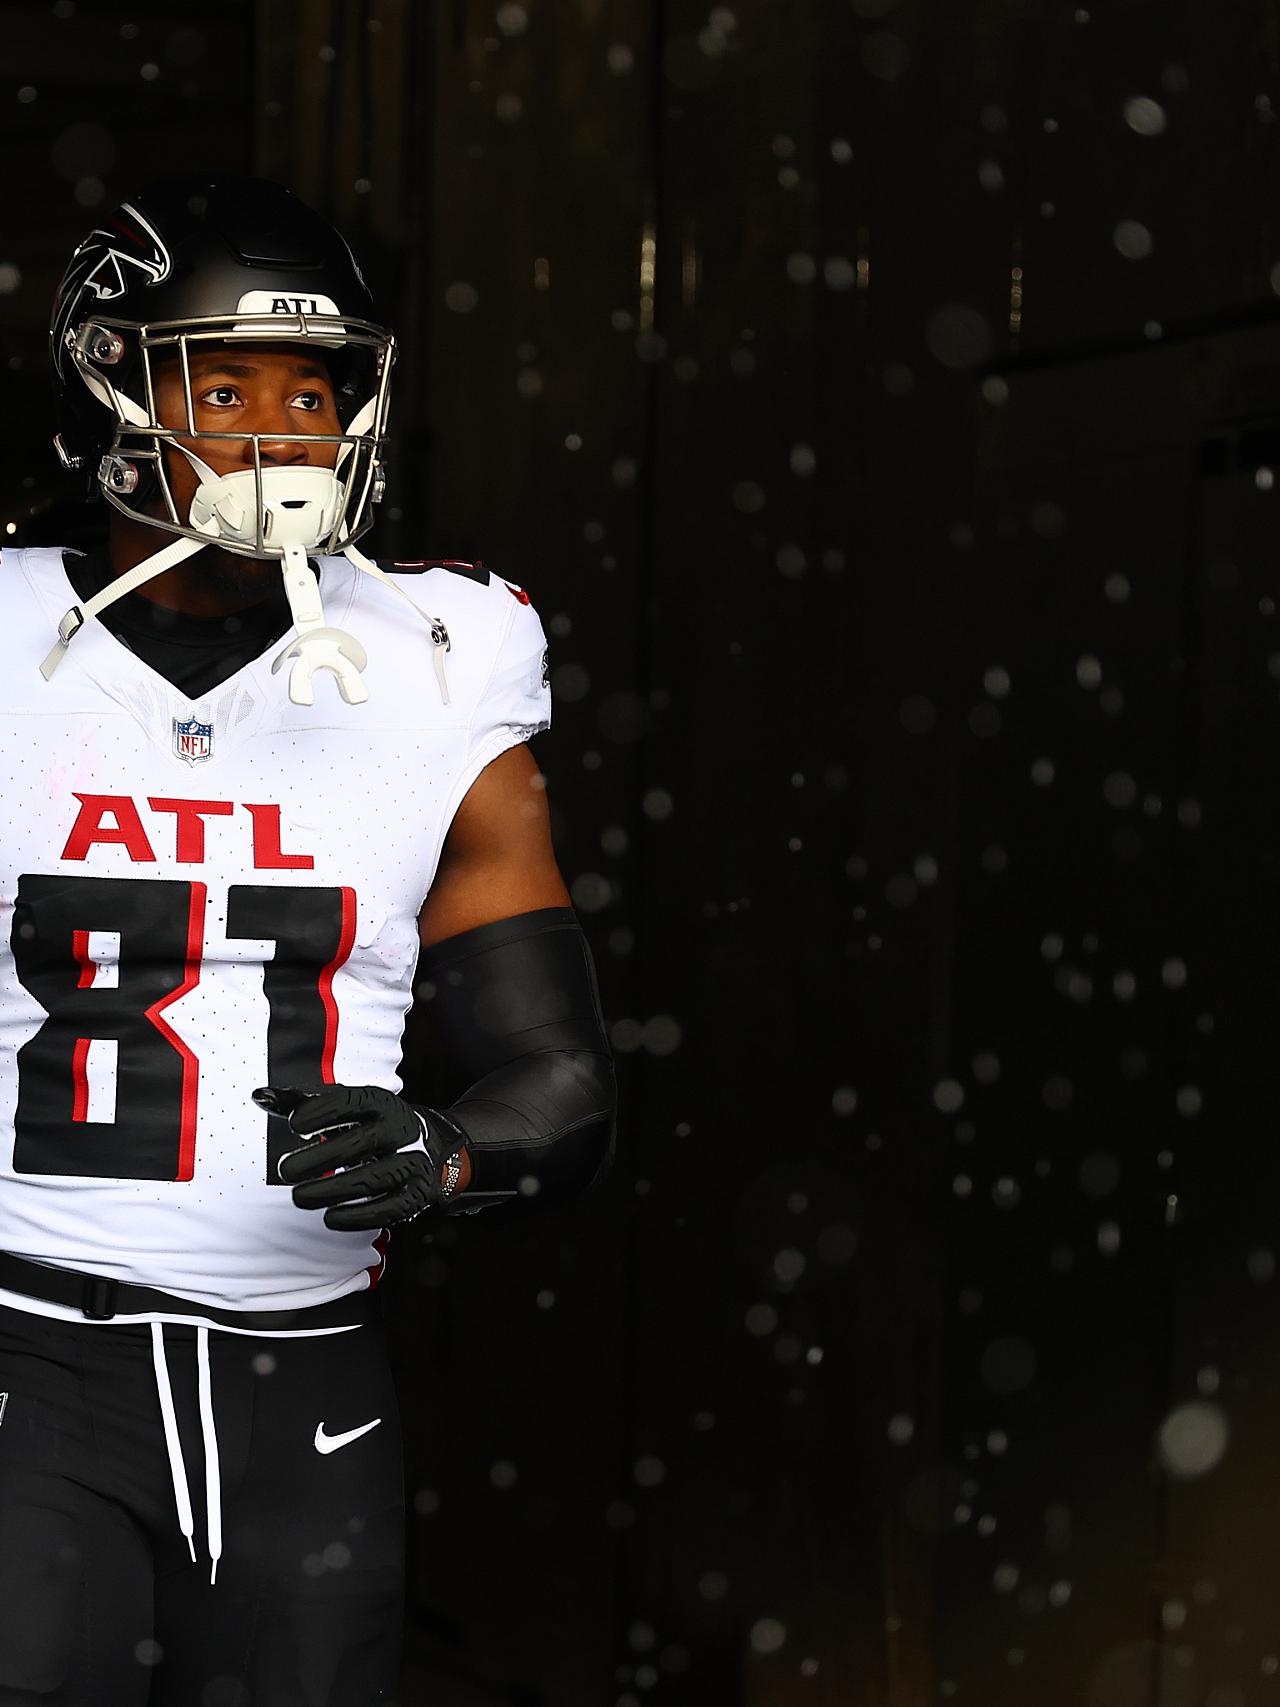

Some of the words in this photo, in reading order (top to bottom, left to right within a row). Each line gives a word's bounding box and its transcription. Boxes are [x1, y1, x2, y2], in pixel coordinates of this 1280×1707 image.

[180, 735, 208, 756] NFL
[60, 792, 314, 870] ATL
[10, 873, 357, 1186] 81
